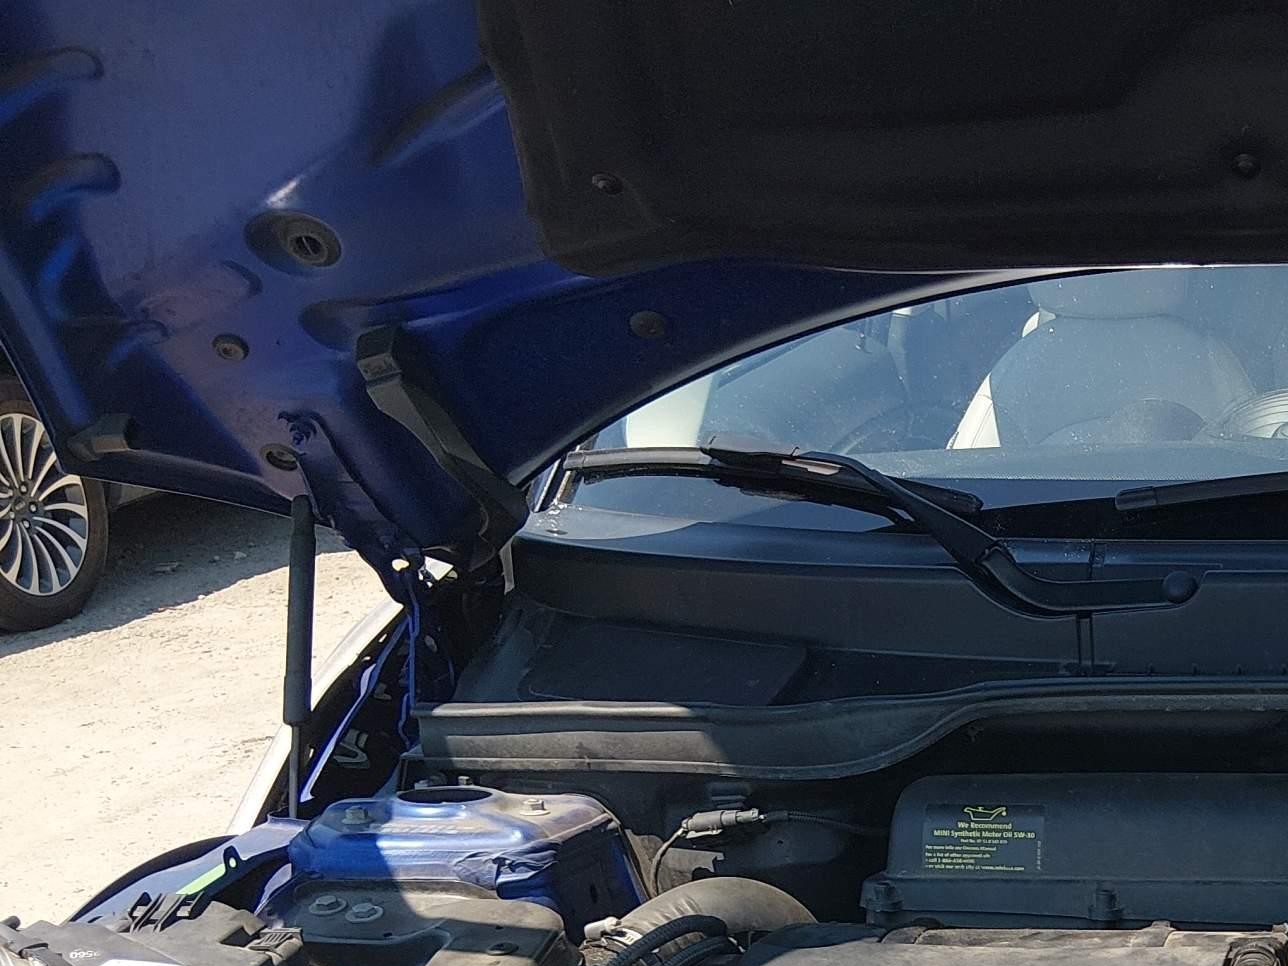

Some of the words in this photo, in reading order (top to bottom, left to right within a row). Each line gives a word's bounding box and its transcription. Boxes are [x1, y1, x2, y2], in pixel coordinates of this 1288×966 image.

[971, 821, 1012, 830] Recommend
[933, 829, 950, 837] MINI
[951, 829, 981, 839] Synthetic
[982, 830, 1002, 838] Motor
[1003, 830, 1013, 838] Oil
[1014, 831, 1036, 839] 5W-30
